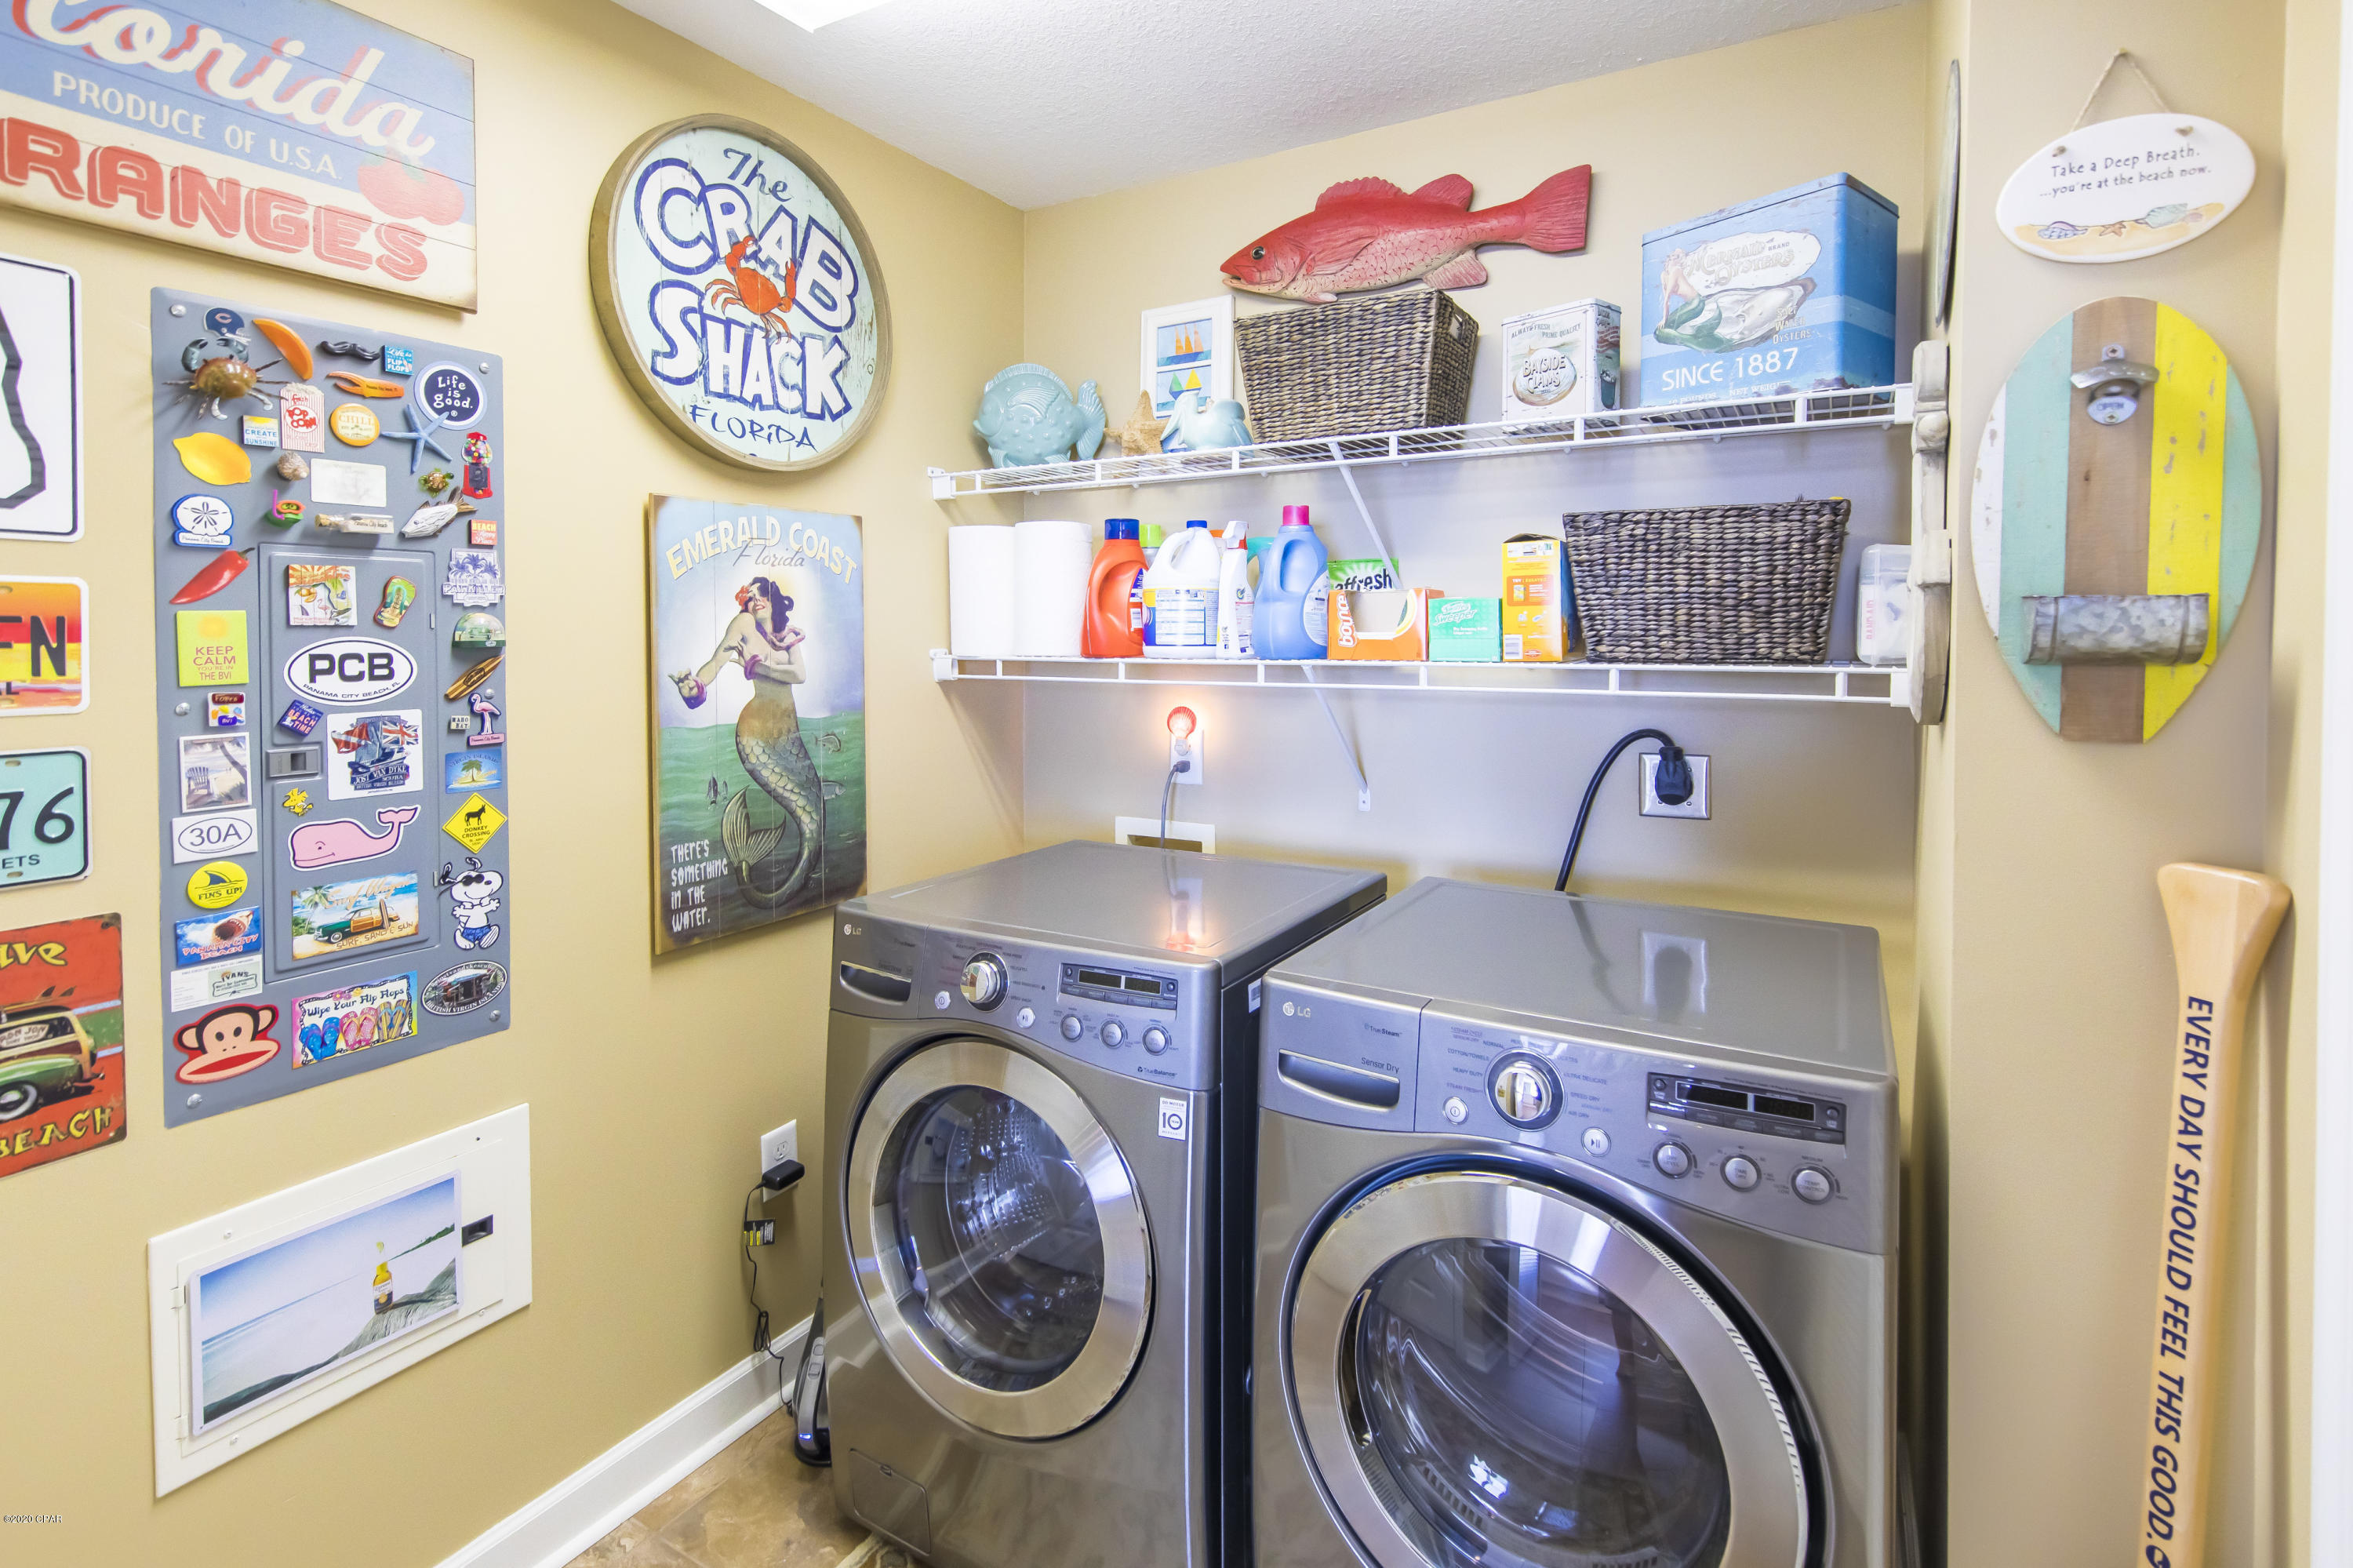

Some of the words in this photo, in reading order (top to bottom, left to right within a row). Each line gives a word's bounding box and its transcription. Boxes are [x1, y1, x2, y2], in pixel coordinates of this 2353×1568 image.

[53, 70, 206, 140] PRODUCE
[224, 126, 256, 155] OF
[270, 139, 344, 181] U.S.A.
[2051, 162, 2085, 178] Take
[2089, 162, 2097, 172] a
[2104, 156, 2140, 169] Deep
[2146, 143, 2201, 164] Breath.
[722, 147, 794, 203] The
[2097, 177, 2109, 189] at
[2113, 173, 2134, 186] the
[2139, 166, 2175, 183] beach
[2180, 165, 2212, 177] now.
[633, 157, 860, 333] CRAB
[1767, 241, 1791, 252] BRAND
[1715, 249, 1795, 286] OYSTERS
[1772, 329, 1813, 344] OYSTERS
[648, 278, 853, 421] SHACK
[387, 364, 409, 373] FLOPS
[1522, 355, 1566, 378] BAYSIDE
[1661, 360, 1725, 391] SINCE
[1735, 347, 1799, 379] 1887
[437, 375, 467, 391] Life
[1526, 372, 1562, 395] CLAMS
[432, 392, 474, 409] good.
[447, 388, 461, 398] is
[285, 406, 309, 420] POP
[290, 416, 317, 429] CORN
[245, 428, 277, 438] CREATE
[245, 438, 278, 447] SUNSHINE
[471, 522, 497, 532] BEACH
[665, 515, 782, 581] EMERALD
[788, 521, 858, 585] COAST
[732, 537, 806, 567] Florida
[1337, 594, 1355, 647] bounce
[1433, 609, 1478, 627] Sweeper
[192, 655, 237, 666] CALM
[195, 646, 234, 656] KEEP
[199, 671, 216, 681] THE
[218, 671, 232, 680] BVI
[307, 652, 395, 684] PCB
[303, 683, 339, 698] PANAMA
[287, 708, 317, 727] BEACH
[293, 721, 312, 734] TIME
[448, 754, 471, 768] VIRGIN
[353, 774, 370, 785] JOST
[373, 769, 387, 779] VAN
[387, 765, 408, 774] DYKE
[189, 823, 243, 847] 30A
[461, 830, 491, 839] CROSSING
[464, 824, 488, 833] DONKEY
[198, 890, 223, 900] FINS
[226, 886, 243, 896] UP!
[325, 885, 365, 911] Surf
[365, 877, 410, 900] Wagon
[686, 884, 706, 906] THE
[231, 933, 259, 946] CITY
[364, 928, 388, 942] SAND
[398, 921, 414, 933] SUN
[200, 944, 244, 961] BEACH
[307, 1005, 331, 1018] Wipe
[333, 998, 358, 1010] Your
[359, 994, 377, 1006] Flip
[380, 988, 405, 1000] Flops
[425, 999, 452, 1013] BRITISH
[453, 1002, 478, 1013] VIRGIN
[478, 981, 504, 1005] ISLANDS
[1297, 1006, 1311, 1018] LG
[1482, 1039, 1505, 1050] NORMAL
[2180, 995, 2213, 1088] EVERY
[1361, 1057, 1385, 1070] Sensor
[1386, 1062, 1400, 1075] Dry
[1162, 1111, 1184, 1130] 10
[2177, 1094, 2206, 1159] DAY
[2165, 1163, 2199, 1291] SHOULD
[2159, 1296, 2192, 1359] FEEL
[2153, 1364, 2185, 1443] THIS
[2146, 1444, 2179, 1541] GOOD.
